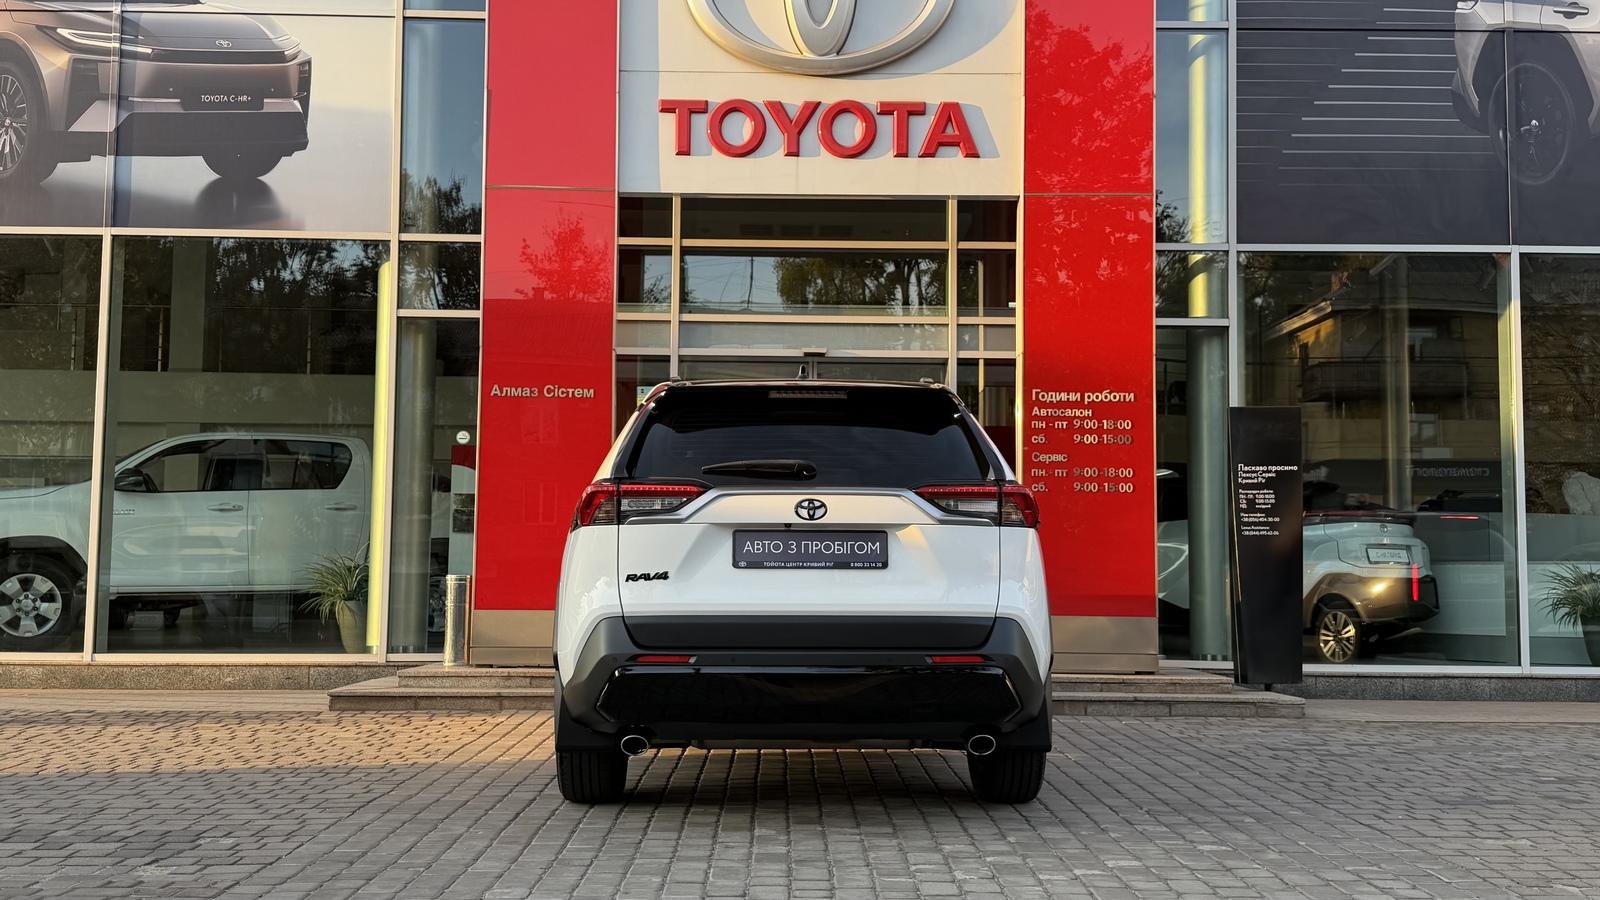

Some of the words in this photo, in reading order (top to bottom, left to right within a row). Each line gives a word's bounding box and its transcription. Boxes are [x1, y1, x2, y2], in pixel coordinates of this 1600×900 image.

[200, 94, 228, 103] TOYOTA
[229, 94, 252, 103] C-HR+
[658, 98, 980, 158] TOYOTA
[490, 383, 539, 397] Алмаз
[543, 384, 594, 398] Сістем
[1031, 388, 1081, 404] Години
[1084, 389, 1135, 405] роботи
[1031, 406, 1093, 417] Автосалон
[1031, 420, 1046, 429] пн
[1054, 420, 1068, 429] пт
[1073, 419, 1132, 430] 9:00-18:00
[1031, 433, 1048, 444] сб.
[1073, 433, 1133, 445] 9:00-15:00
[1031, 451, 1068, 464] Сервіс
[1054, 468, 1068, 477] пт
[1073, 467, 1134, 478] 9:00-18:00
[1031, 481, 1049, 492] сб.
[1073, 481, 1134, 493] 9:00-15:00
[743, 540, 783, 554] АВТО
[787, 541, 797, 554] З
[801, 541, 880, 554] ПРОБІГОМ
[625, 570, 670, 582] RAV4
